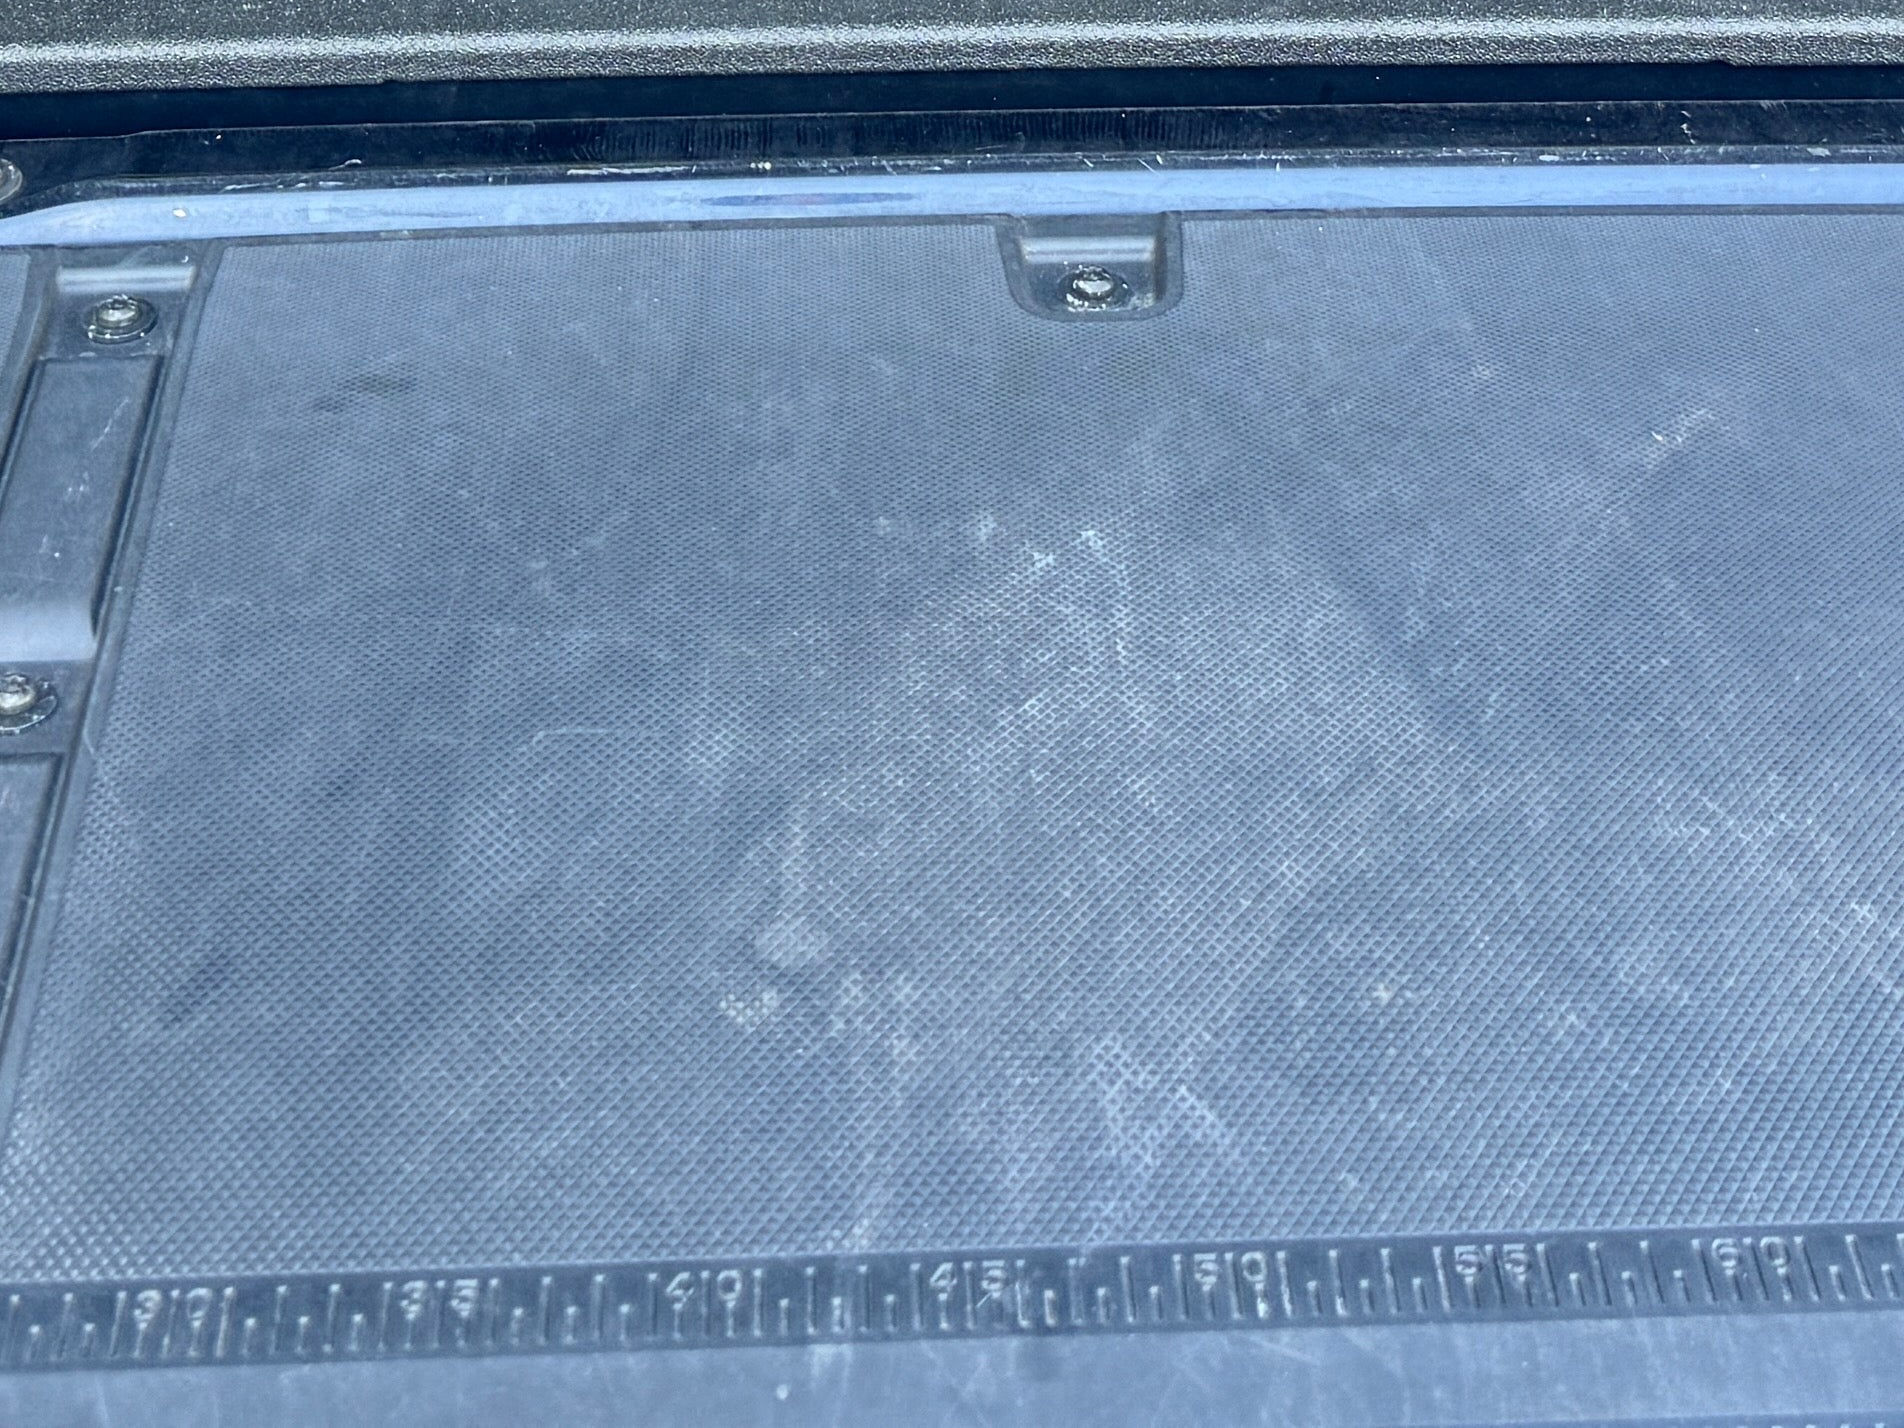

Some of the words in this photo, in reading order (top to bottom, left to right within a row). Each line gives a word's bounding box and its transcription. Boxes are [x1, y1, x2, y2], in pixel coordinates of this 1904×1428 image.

[132, 1287, 214, 1324] 30
[399, 1279, 479, 1316] 35
[665, 1269, 743, 1302] 40
[928, 1261, 1007, 1292] 45
[1193, 1251, 1268, 1286] 50
[1454, 1243, 1531, 1275] 55
[1711, 1236, 1791, 1268] 60
